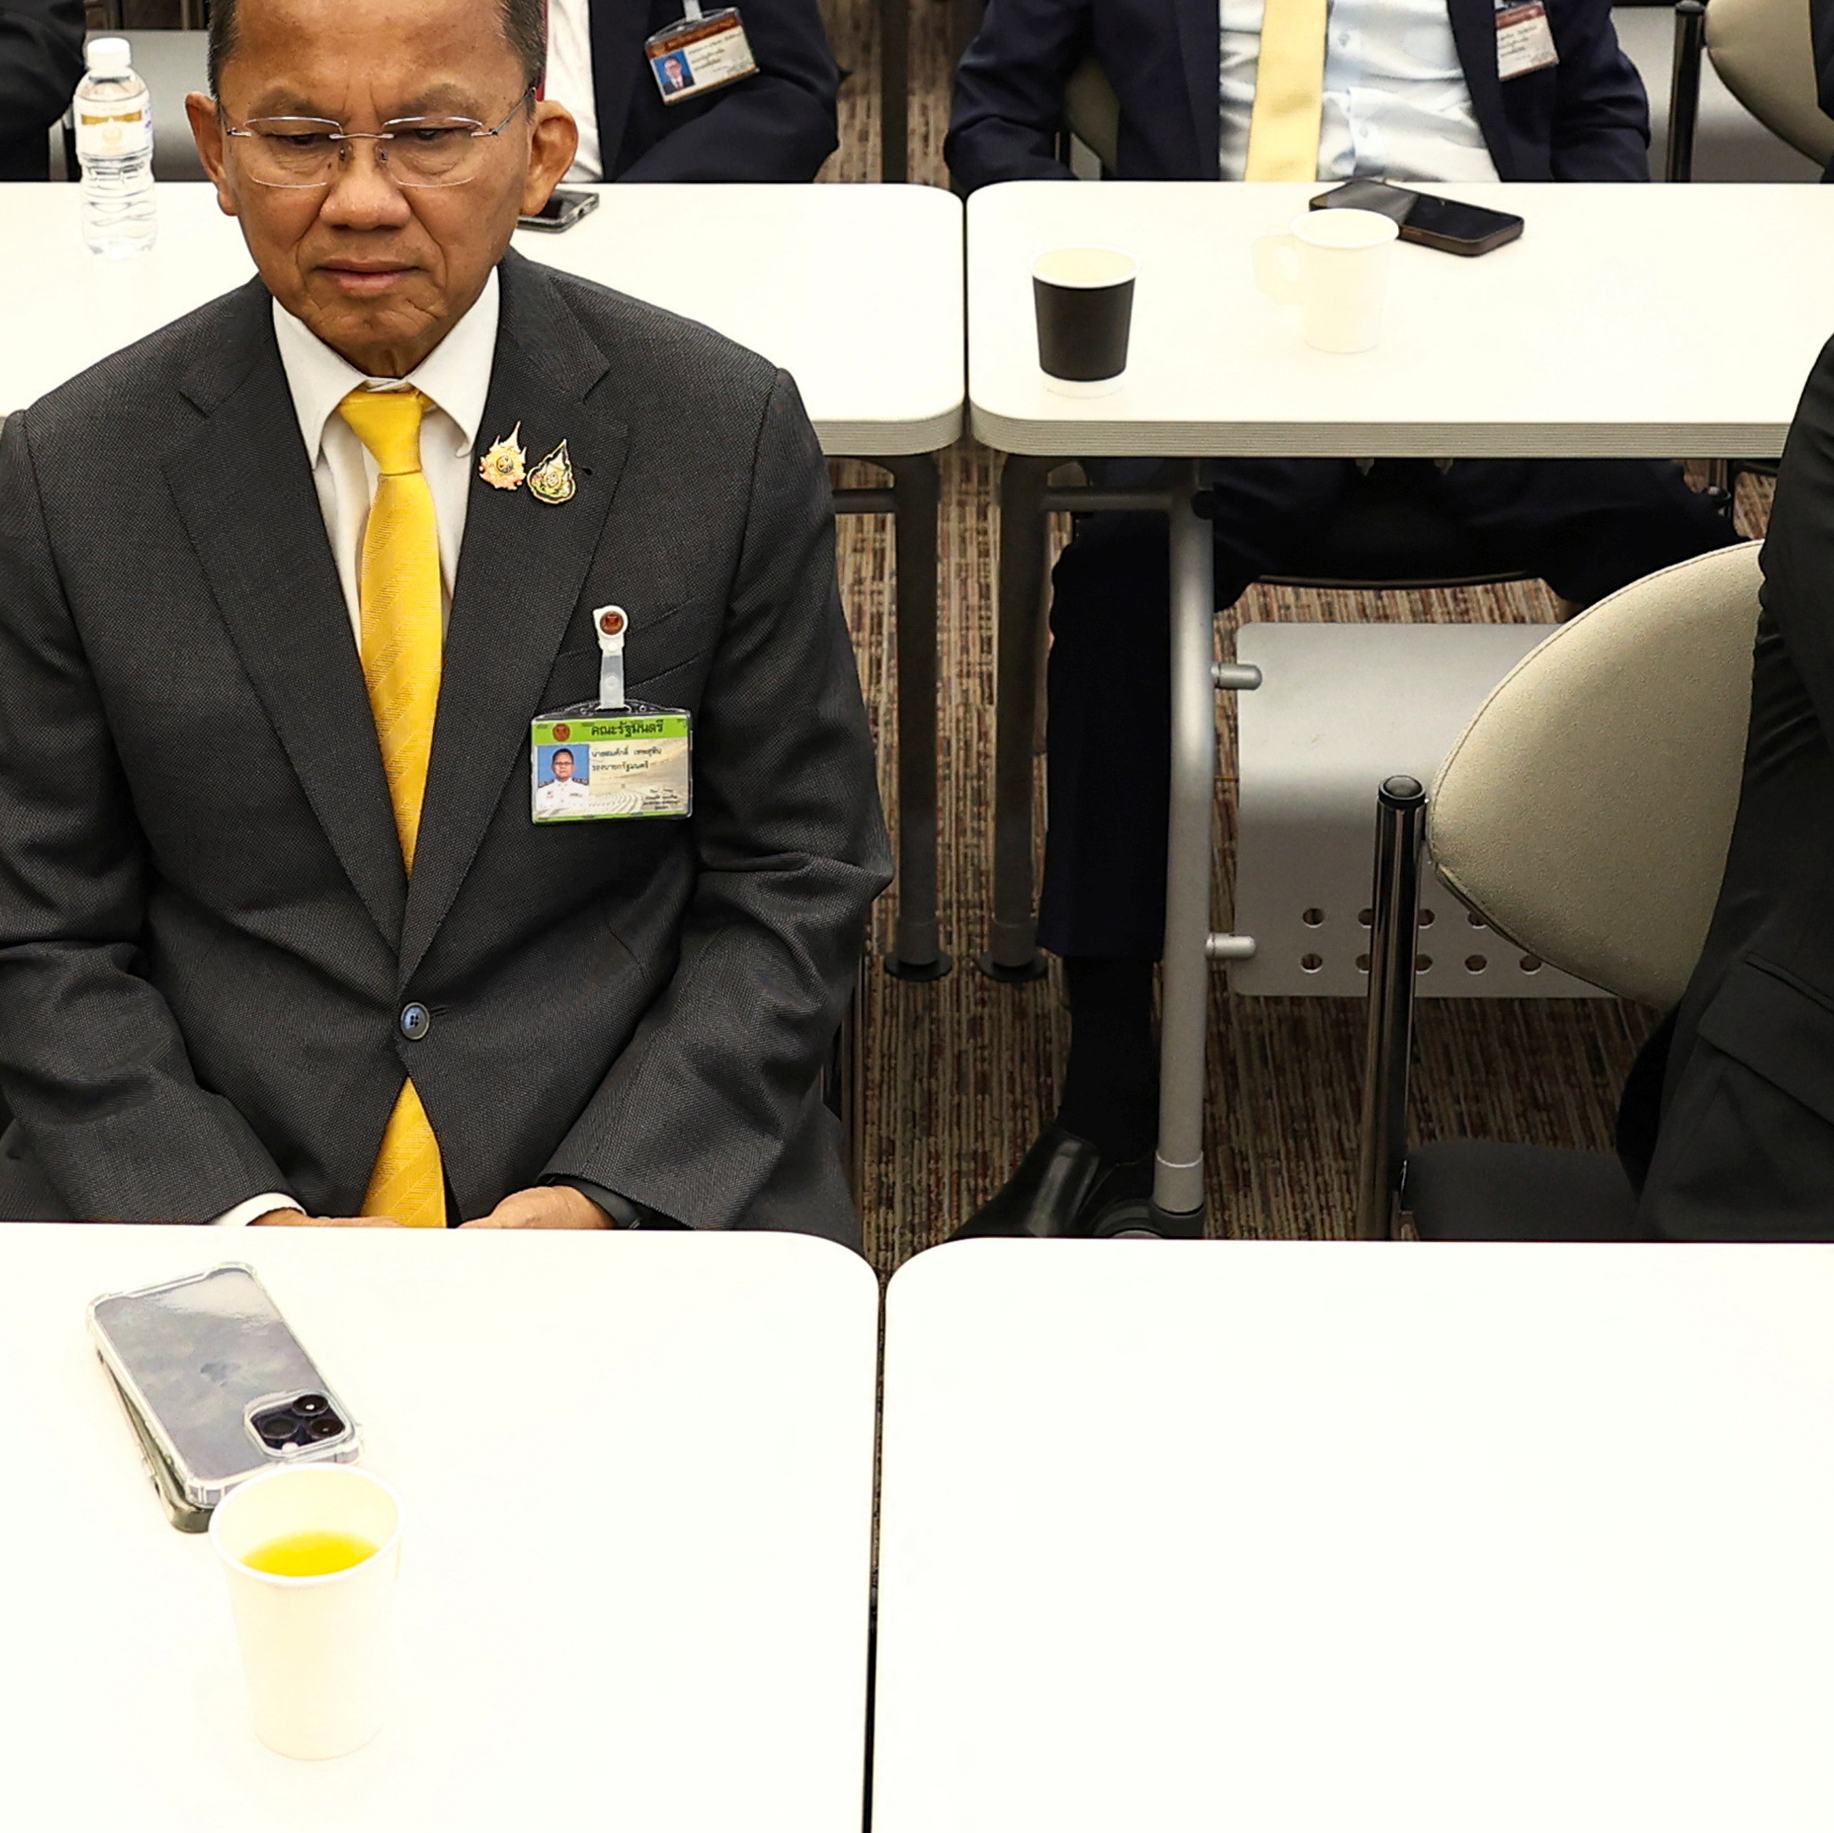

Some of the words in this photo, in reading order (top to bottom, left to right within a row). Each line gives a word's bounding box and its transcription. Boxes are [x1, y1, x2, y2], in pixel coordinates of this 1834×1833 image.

[591, 719, 664, 737] คณะรัฐมนตรี
